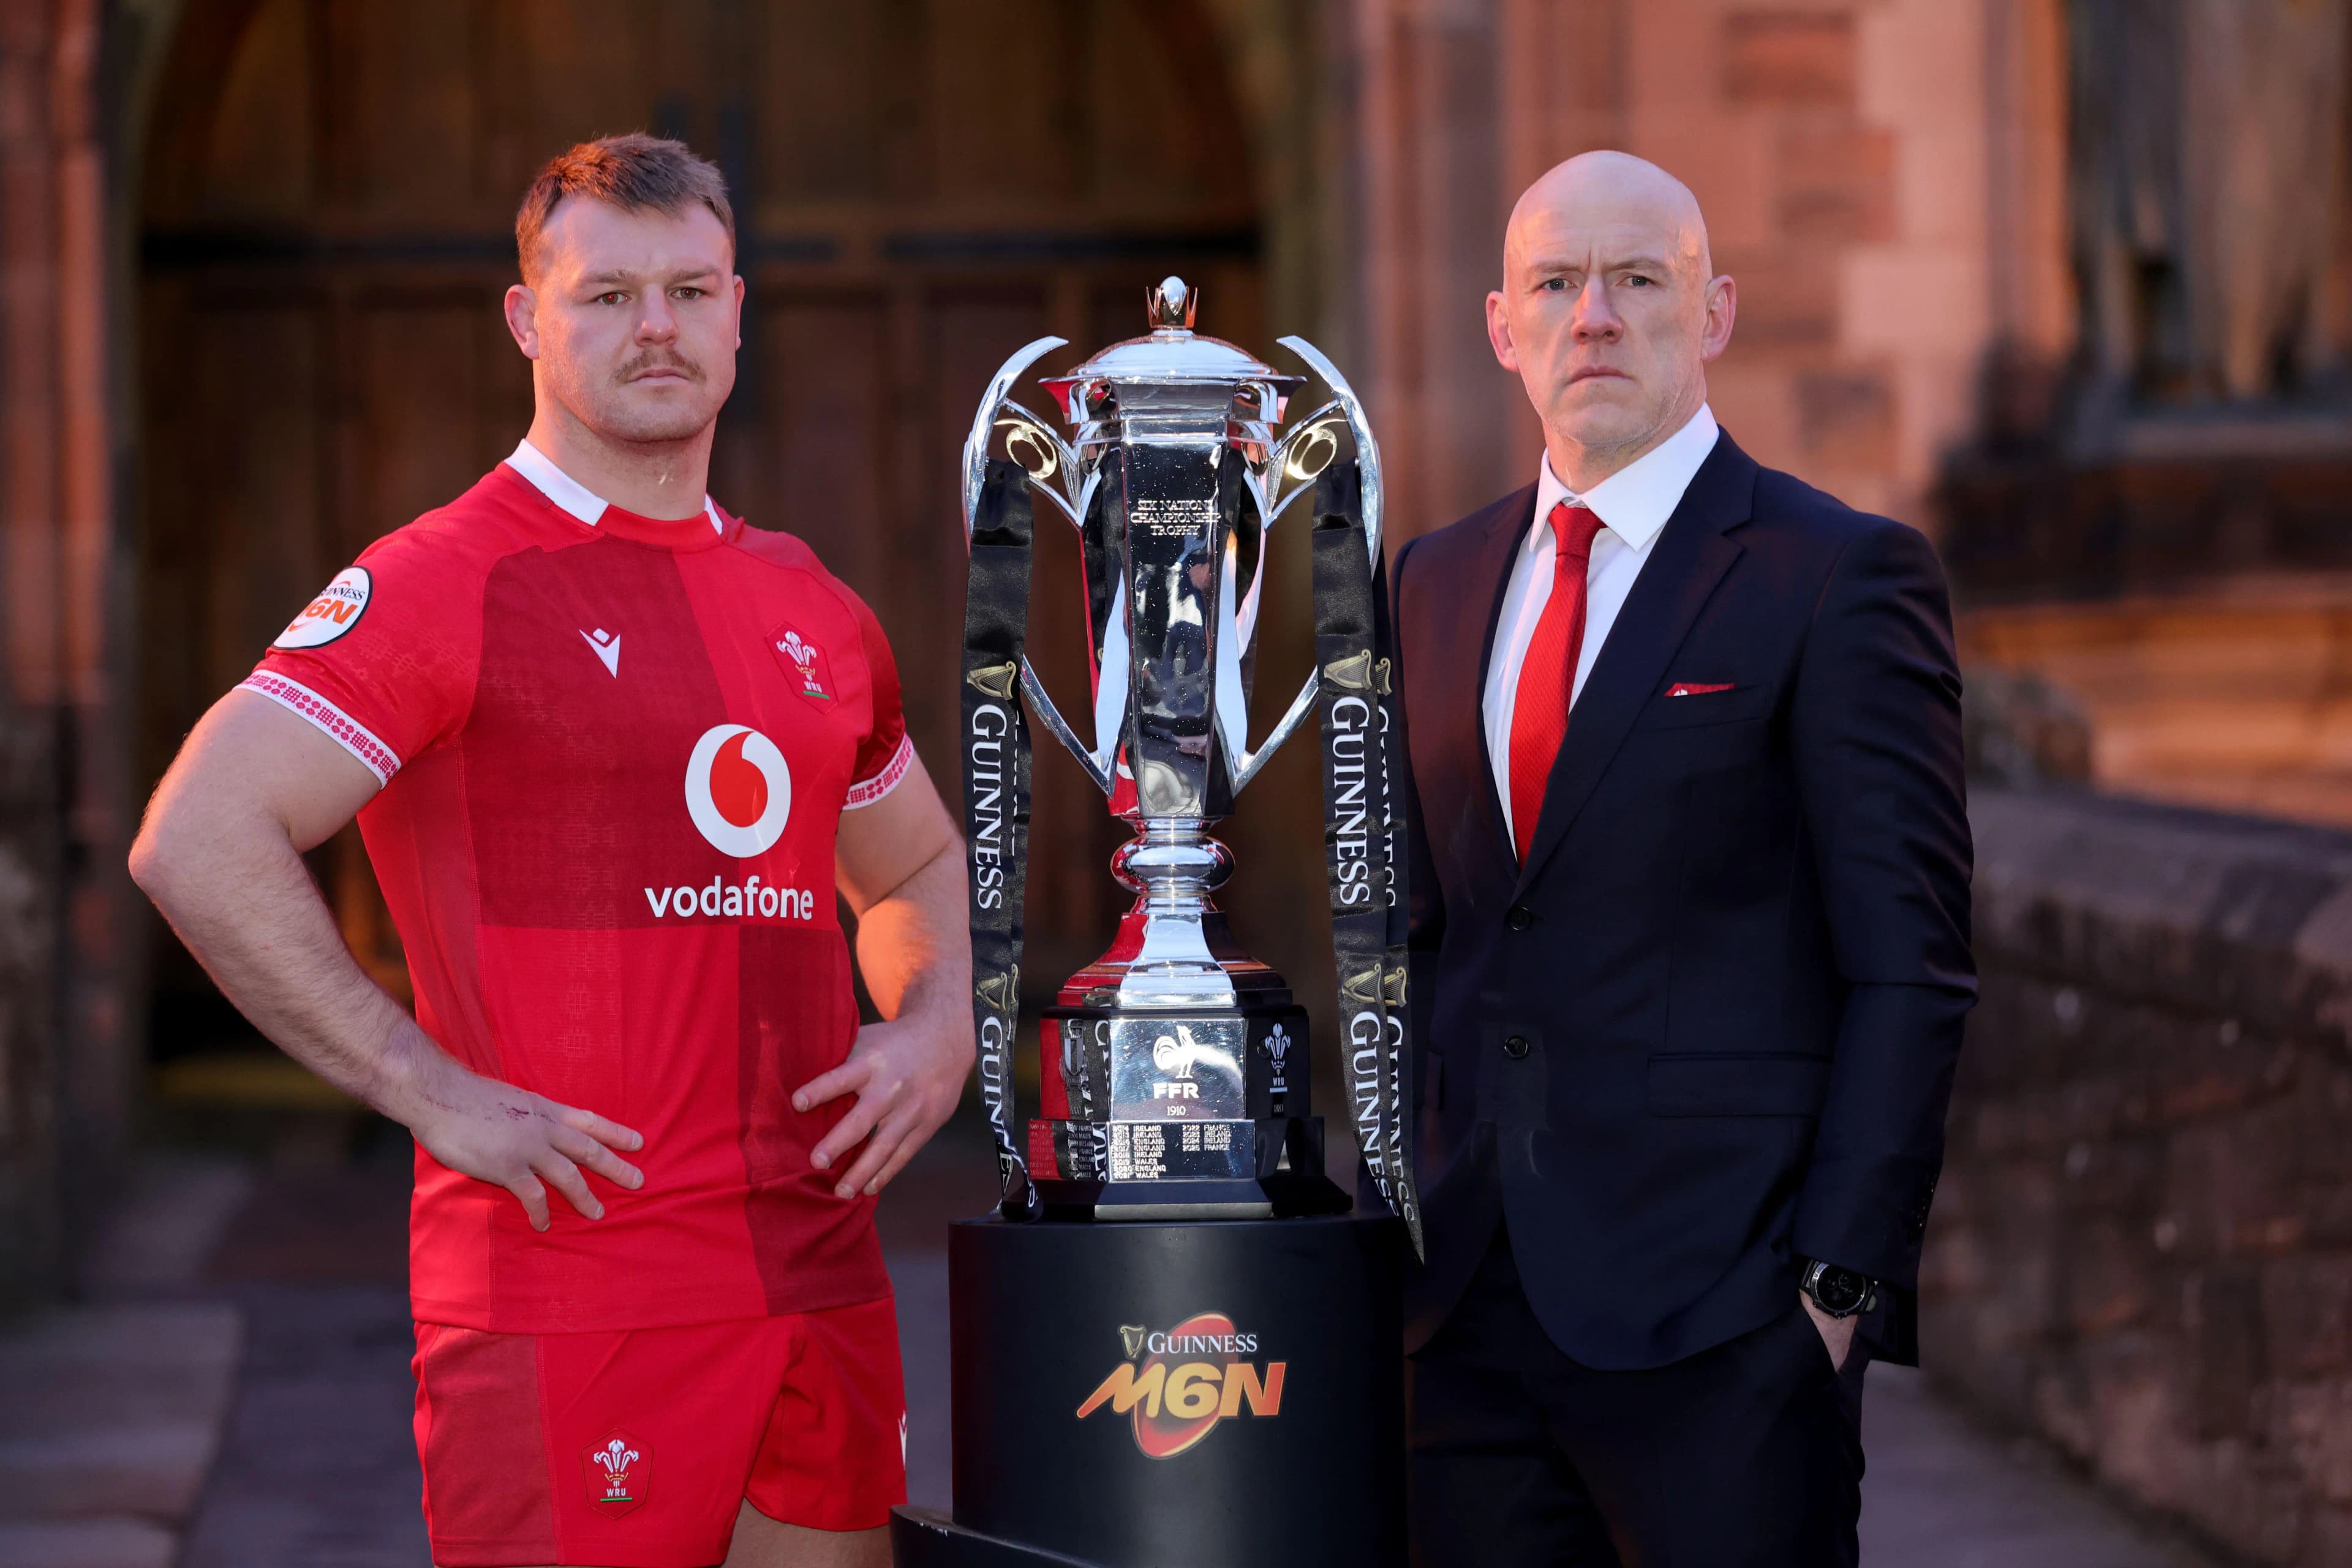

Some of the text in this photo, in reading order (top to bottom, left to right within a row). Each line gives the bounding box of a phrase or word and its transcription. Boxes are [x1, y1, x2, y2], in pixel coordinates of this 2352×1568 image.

[1137, 500, 1157, 510] SIX
[1131, 513, 1221, 523] CHAMPIONSHIP
[1150, 525, 1200, 535] TROPHY
[300, 598, 358, 624] 6N
[804, 680, 822, 693] WRU
[972, 704, 1007, 909] GUINNESS
[1332, 696, 1371, 905] GUINNESS
[644, 875, 813, 920] vodafone
[1273, 1077, 1284, 1086] WRU
[1153, 1082, 1199, 1099] FFR
[1167, 1105, 1186, 1116] 1910
[1147, 1333, 1257, 1354] GUINNESS
[1077, 1362, 1286, 1419] M6N
[606, 1488, 626, 1497] WRU
